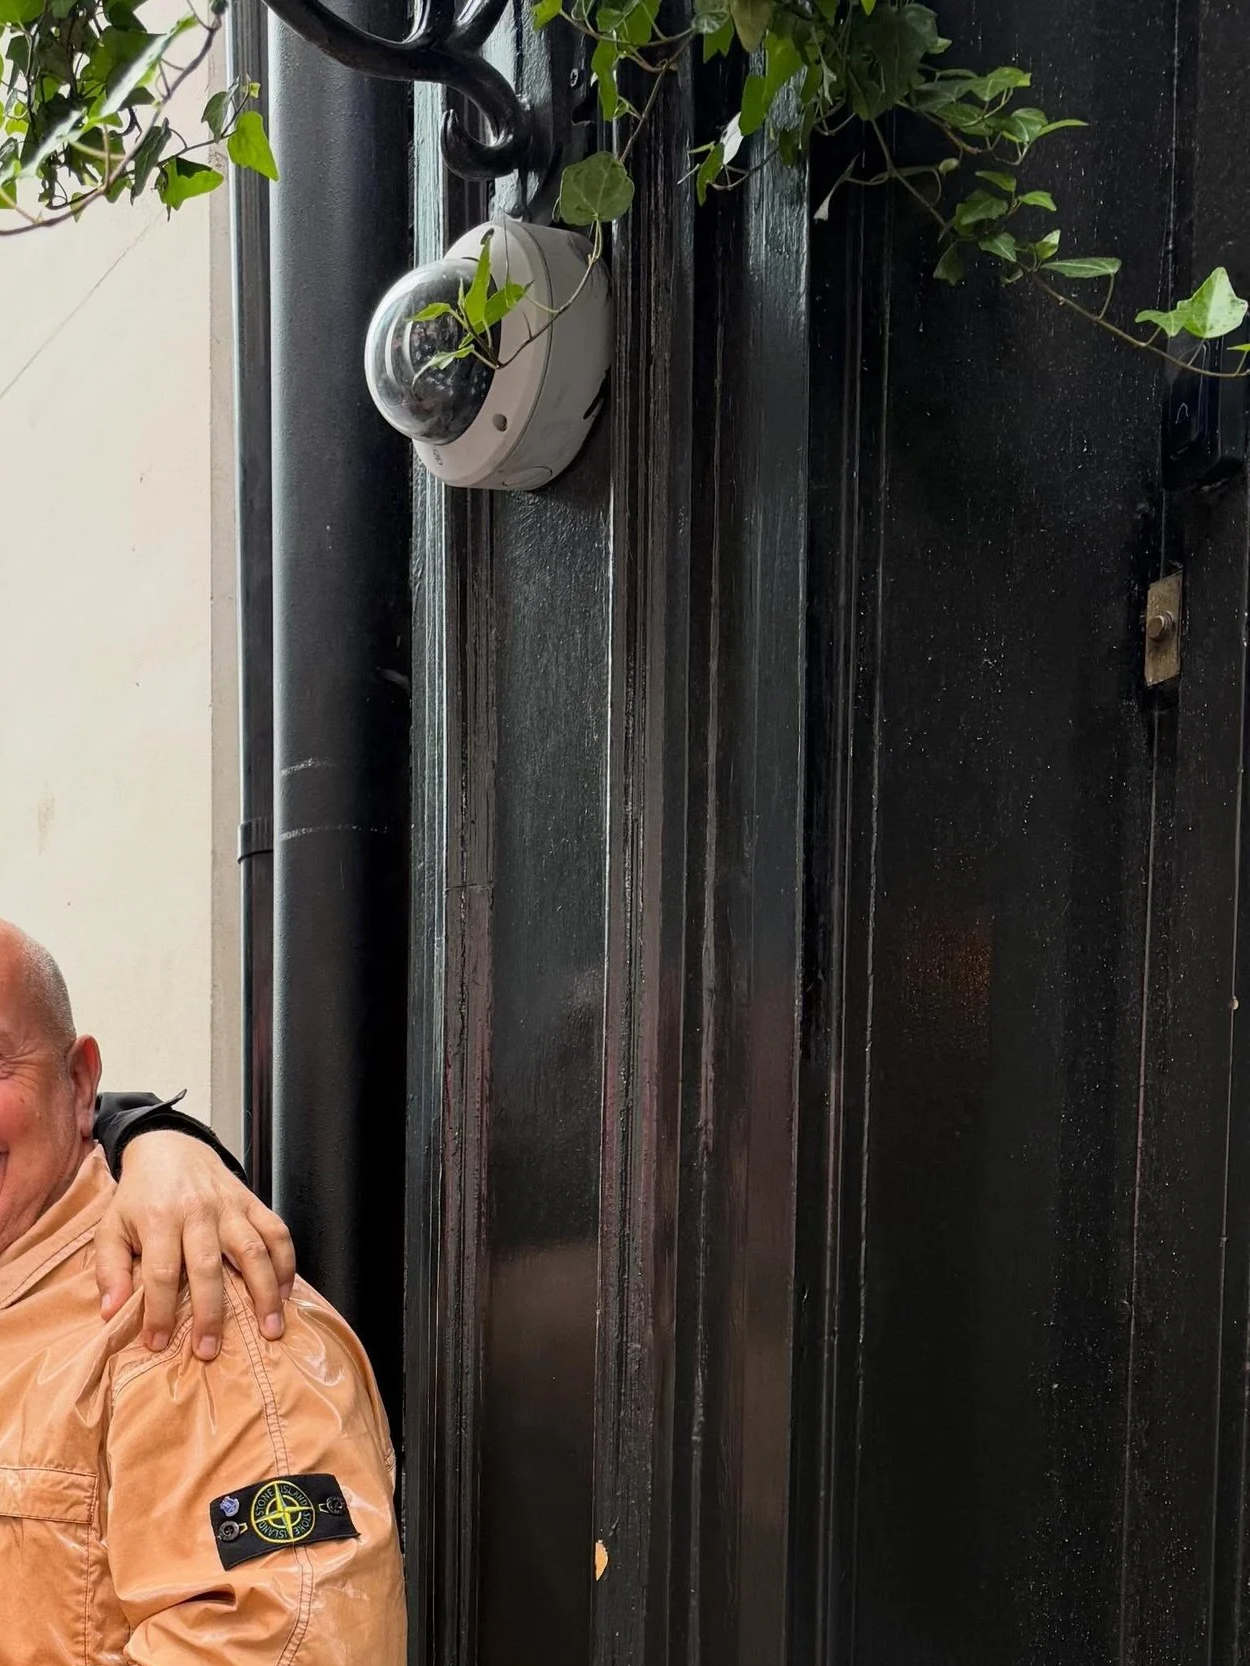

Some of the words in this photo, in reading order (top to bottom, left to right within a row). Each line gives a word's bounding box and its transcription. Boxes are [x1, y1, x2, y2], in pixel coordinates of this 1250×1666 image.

[255, 1488, 275, 1517] STONE
[280, 1485, 308, 1506] ISLAND
[258, 1520, 288, 1539] ISLAND
[293, 1511, 311, 1536] STONE
